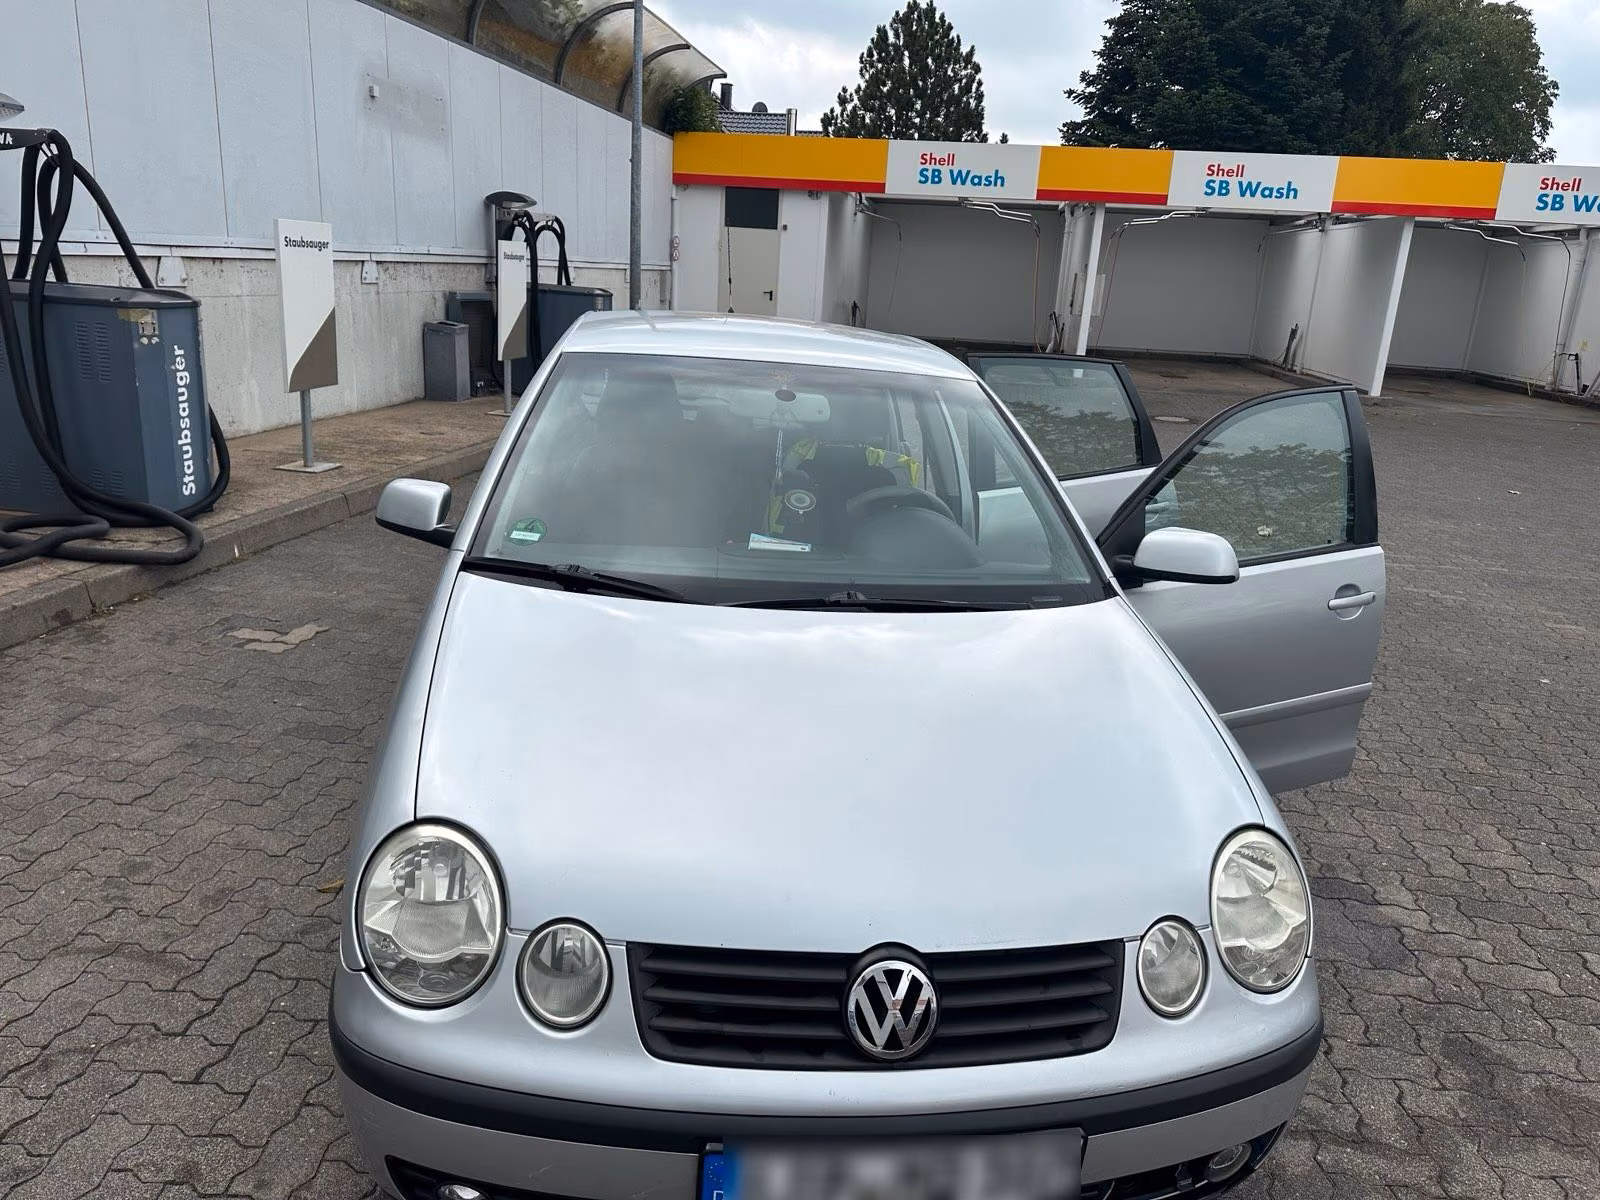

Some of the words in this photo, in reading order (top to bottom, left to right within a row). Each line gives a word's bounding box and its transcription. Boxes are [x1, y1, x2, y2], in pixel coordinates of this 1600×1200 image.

[920, 152, 955, 166] Shell
[918, 167, 942, 184] SB
[949, 169, 1005, 187] Wash
[1206, 164, 1245, 177] Shell
[1204, 179, 1230, 196] SB
[1238, 181, 1298, 199] Wash
[1540, 177, 1582, 191] Shell
[1536, 193, 1564, 211] SB
[1573, 195, 1600, 212] W
[284, 236, 329, 251] Staubsauger
[174, 345, 196, 496] Staubsauger
[848, 961, 937, 1059] VW
